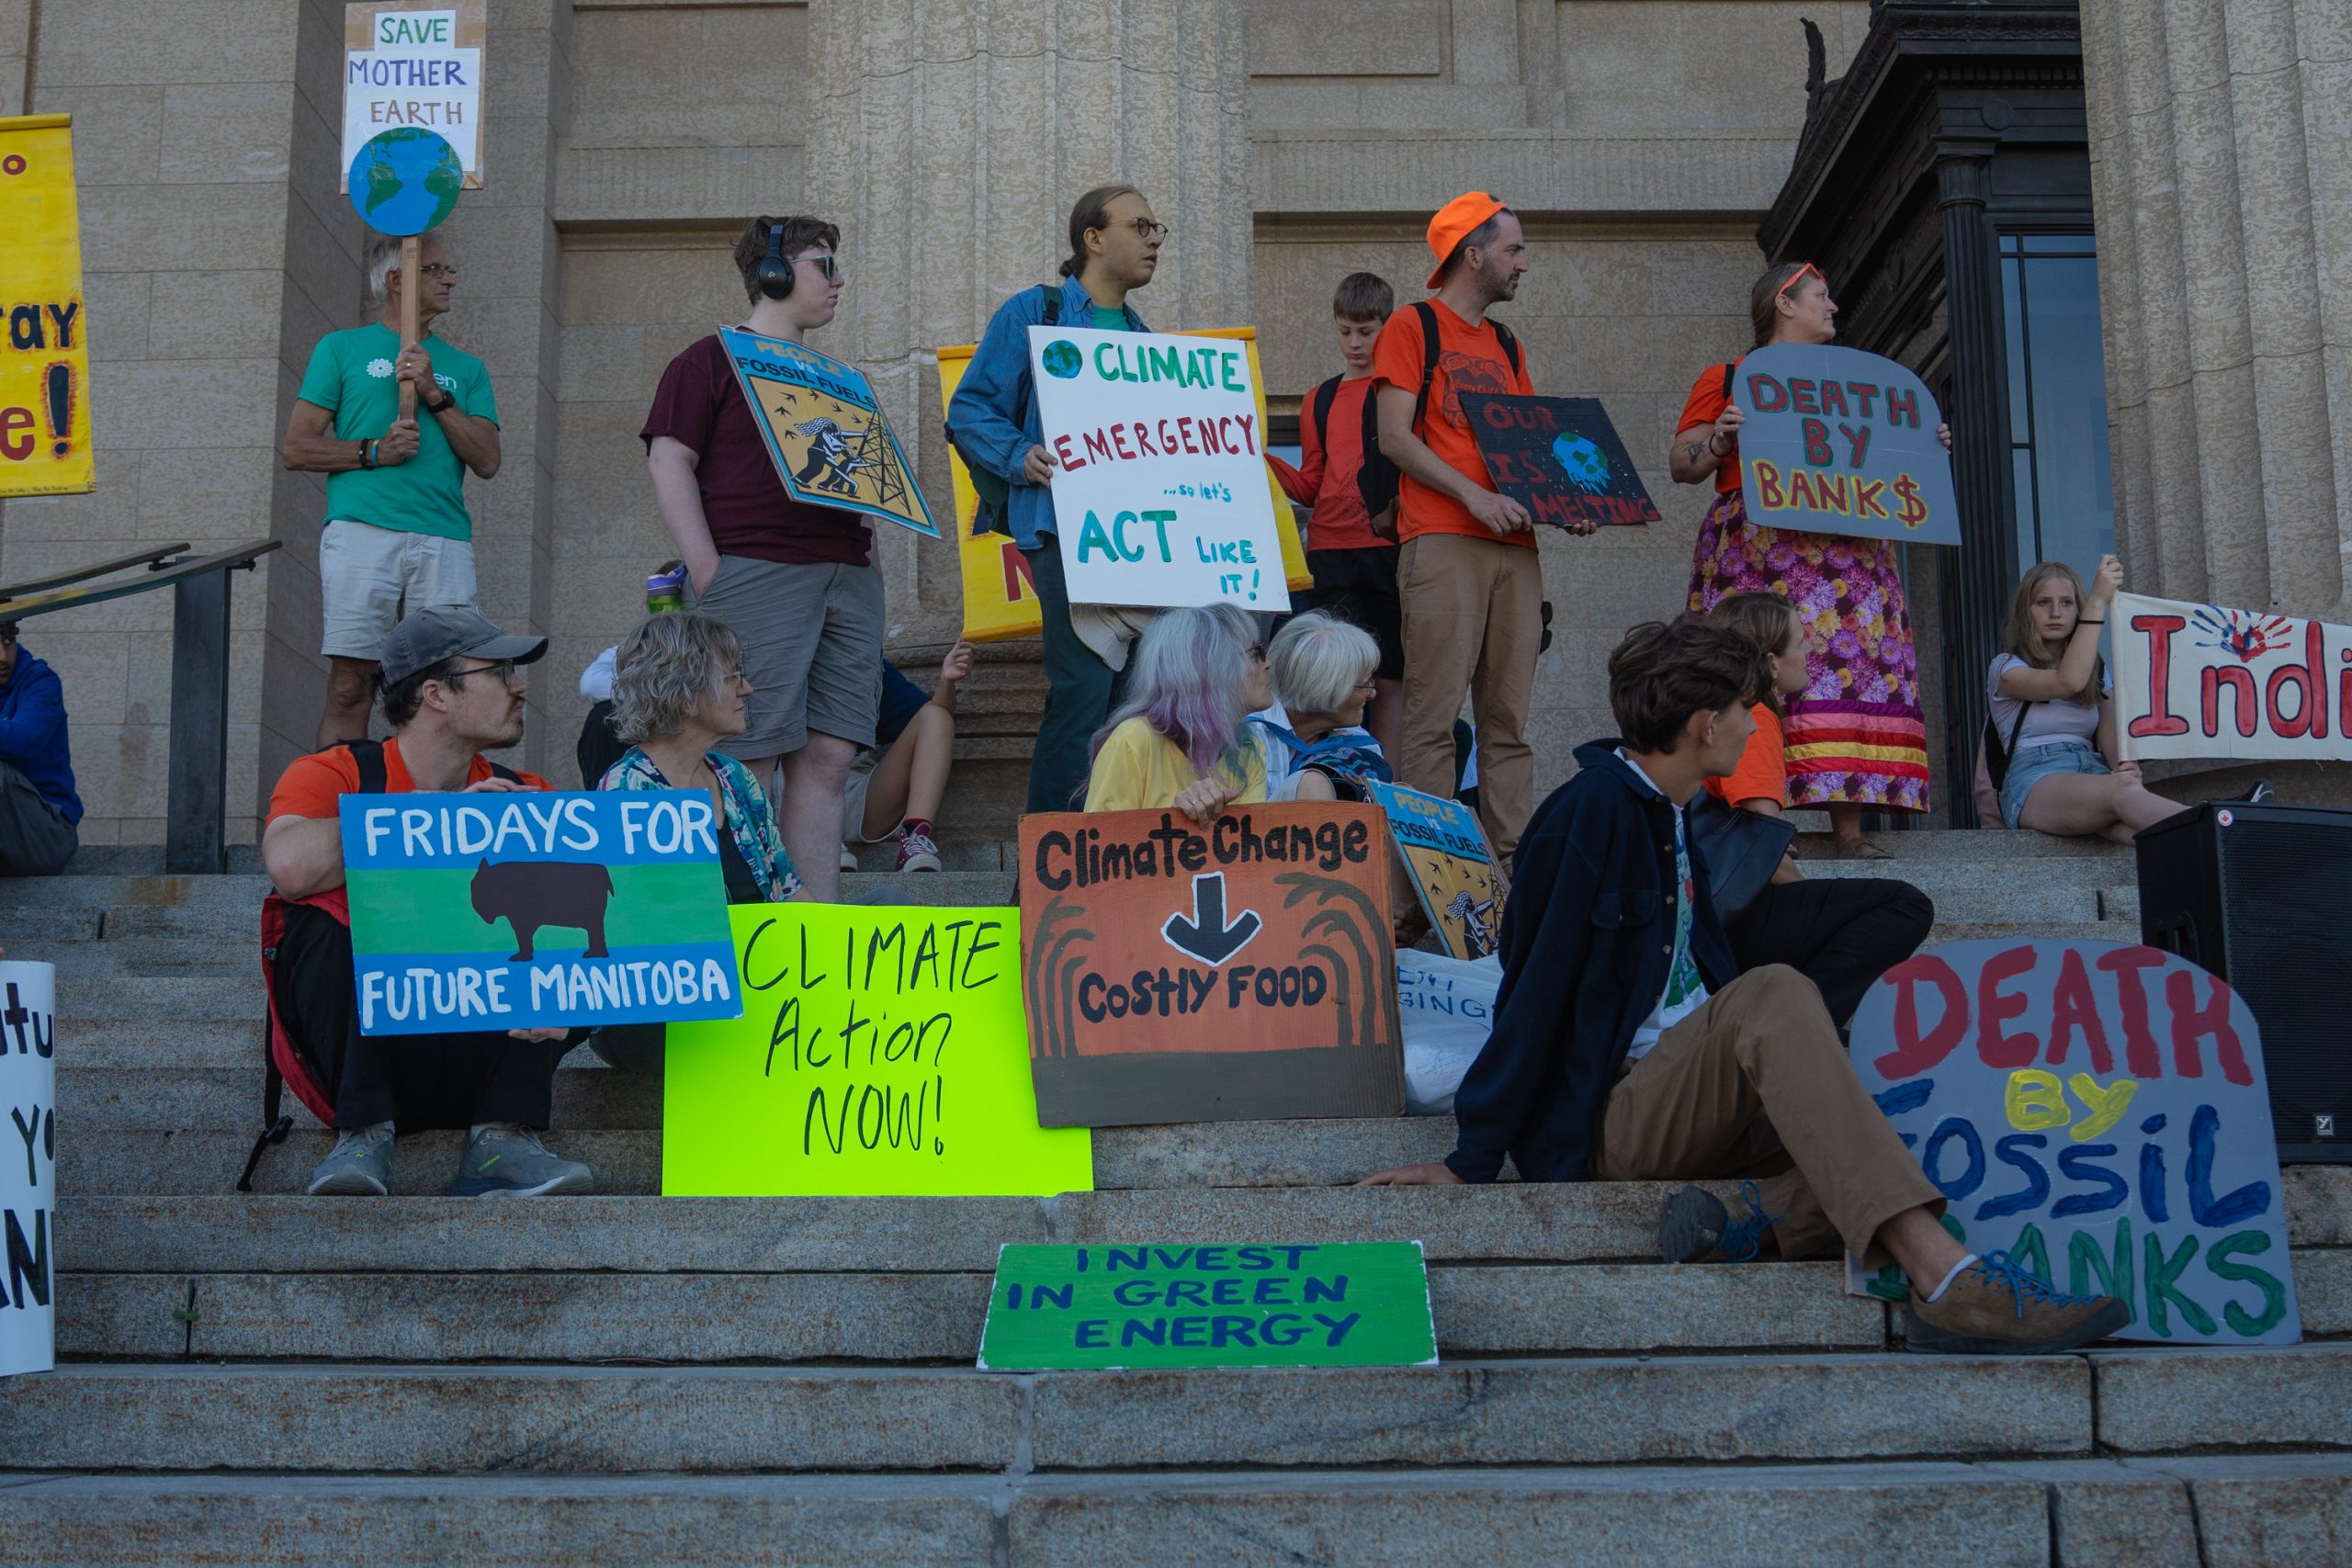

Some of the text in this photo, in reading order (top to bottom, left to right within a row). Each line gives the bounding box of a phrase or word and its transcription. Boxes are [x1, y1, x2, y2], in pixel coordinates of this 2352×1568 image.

[379, 17, 448, 44] SAVE
[349, 59, 468, 86] MOTHER
[370, 99, 462, 126] EARTH
[736, 356, 879, 410] FOSSIL FUELS
[755, 340, 843, 378] PEOPLE
[1093, 342, 1246, 392] CLIMATE
[1482, 401, 1559, 432] OUR
[1747, 373, 1921, 429] DEATH
[1054, 413, 1256, 471] EMERGENCY
[1487, 449, 1548, 484] IS
[1802, 418, 1871, 469] BY
[1199, 481, 1232, 502] let's
[1532, 491, 1662, 524] MELTING
[1753, 459, 1928, 530] BANK$
[1077, 509, 1258, 564] ACT LIKE
[366, 798, 718, 856] FRIDAYS FOR
[1393, 791, 1460, 825] PEOPLE
[1036, 813, 1370, 891] Climate Change
[1388, 818, 1491, 858] FOSSIL FUELS
[742, 918, 1001, 995] CLIMATE
[362, 958, 730, 1030] FUTURE MANITOBA
[1227, 964, 1327, 1009] FOOD
[765, 997, 953, 1077] Action
[1873, 944, 2255, 1088] DEATH
[804, 1074, 944, 1157] NOW!
[2004, 1068, 2139, 1142] BY
[1077, 1246, 1319, 1272] INVEST
[1007, 1275, 1349, 1311] IN GREEN
[1074, 1312, 1362, 1348] ENERGY
